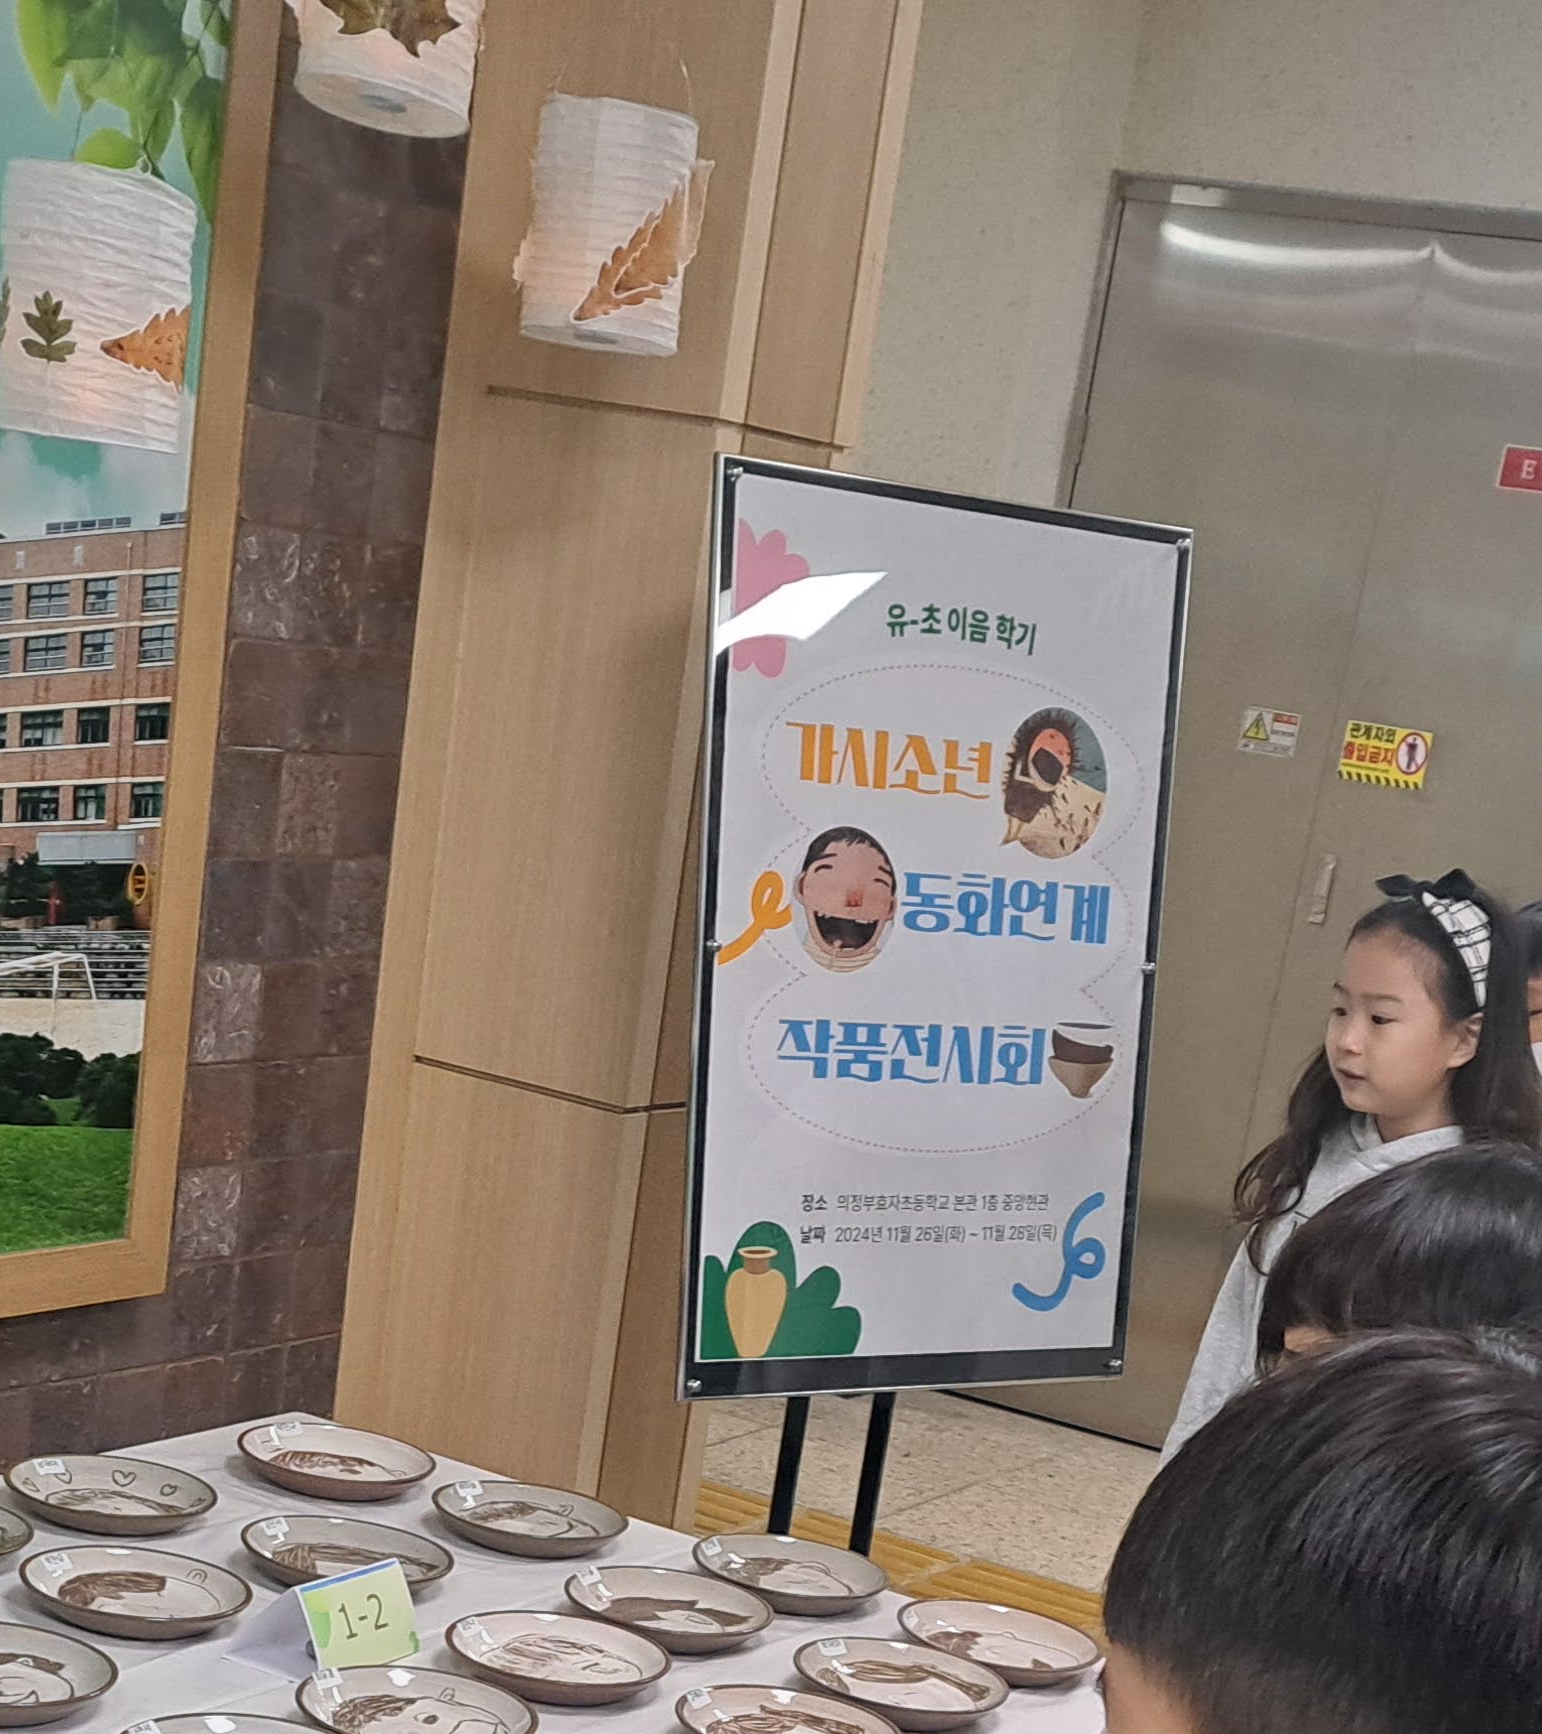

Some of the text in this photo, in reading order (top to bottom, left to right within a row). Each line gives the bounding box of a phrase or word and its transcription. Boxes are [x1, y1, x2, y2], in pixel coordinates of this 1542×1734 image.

[887, 603, 1037, 656] 유-초 이음 학기
[786, 721, 992, 799] 가시소년
[1343, 741, 1395, 766] 출입금지
[900, 871, 1111, 945] 동화연계
[777, 1018, 1046, 1085] 작품전시회
[801, 1194, 828, 1212] 장소
[835, 1225, 883, 1243] 2024년
[887, 1225, 911, 1244] 11월
[339, 1593, 389, 1640] 1-2
